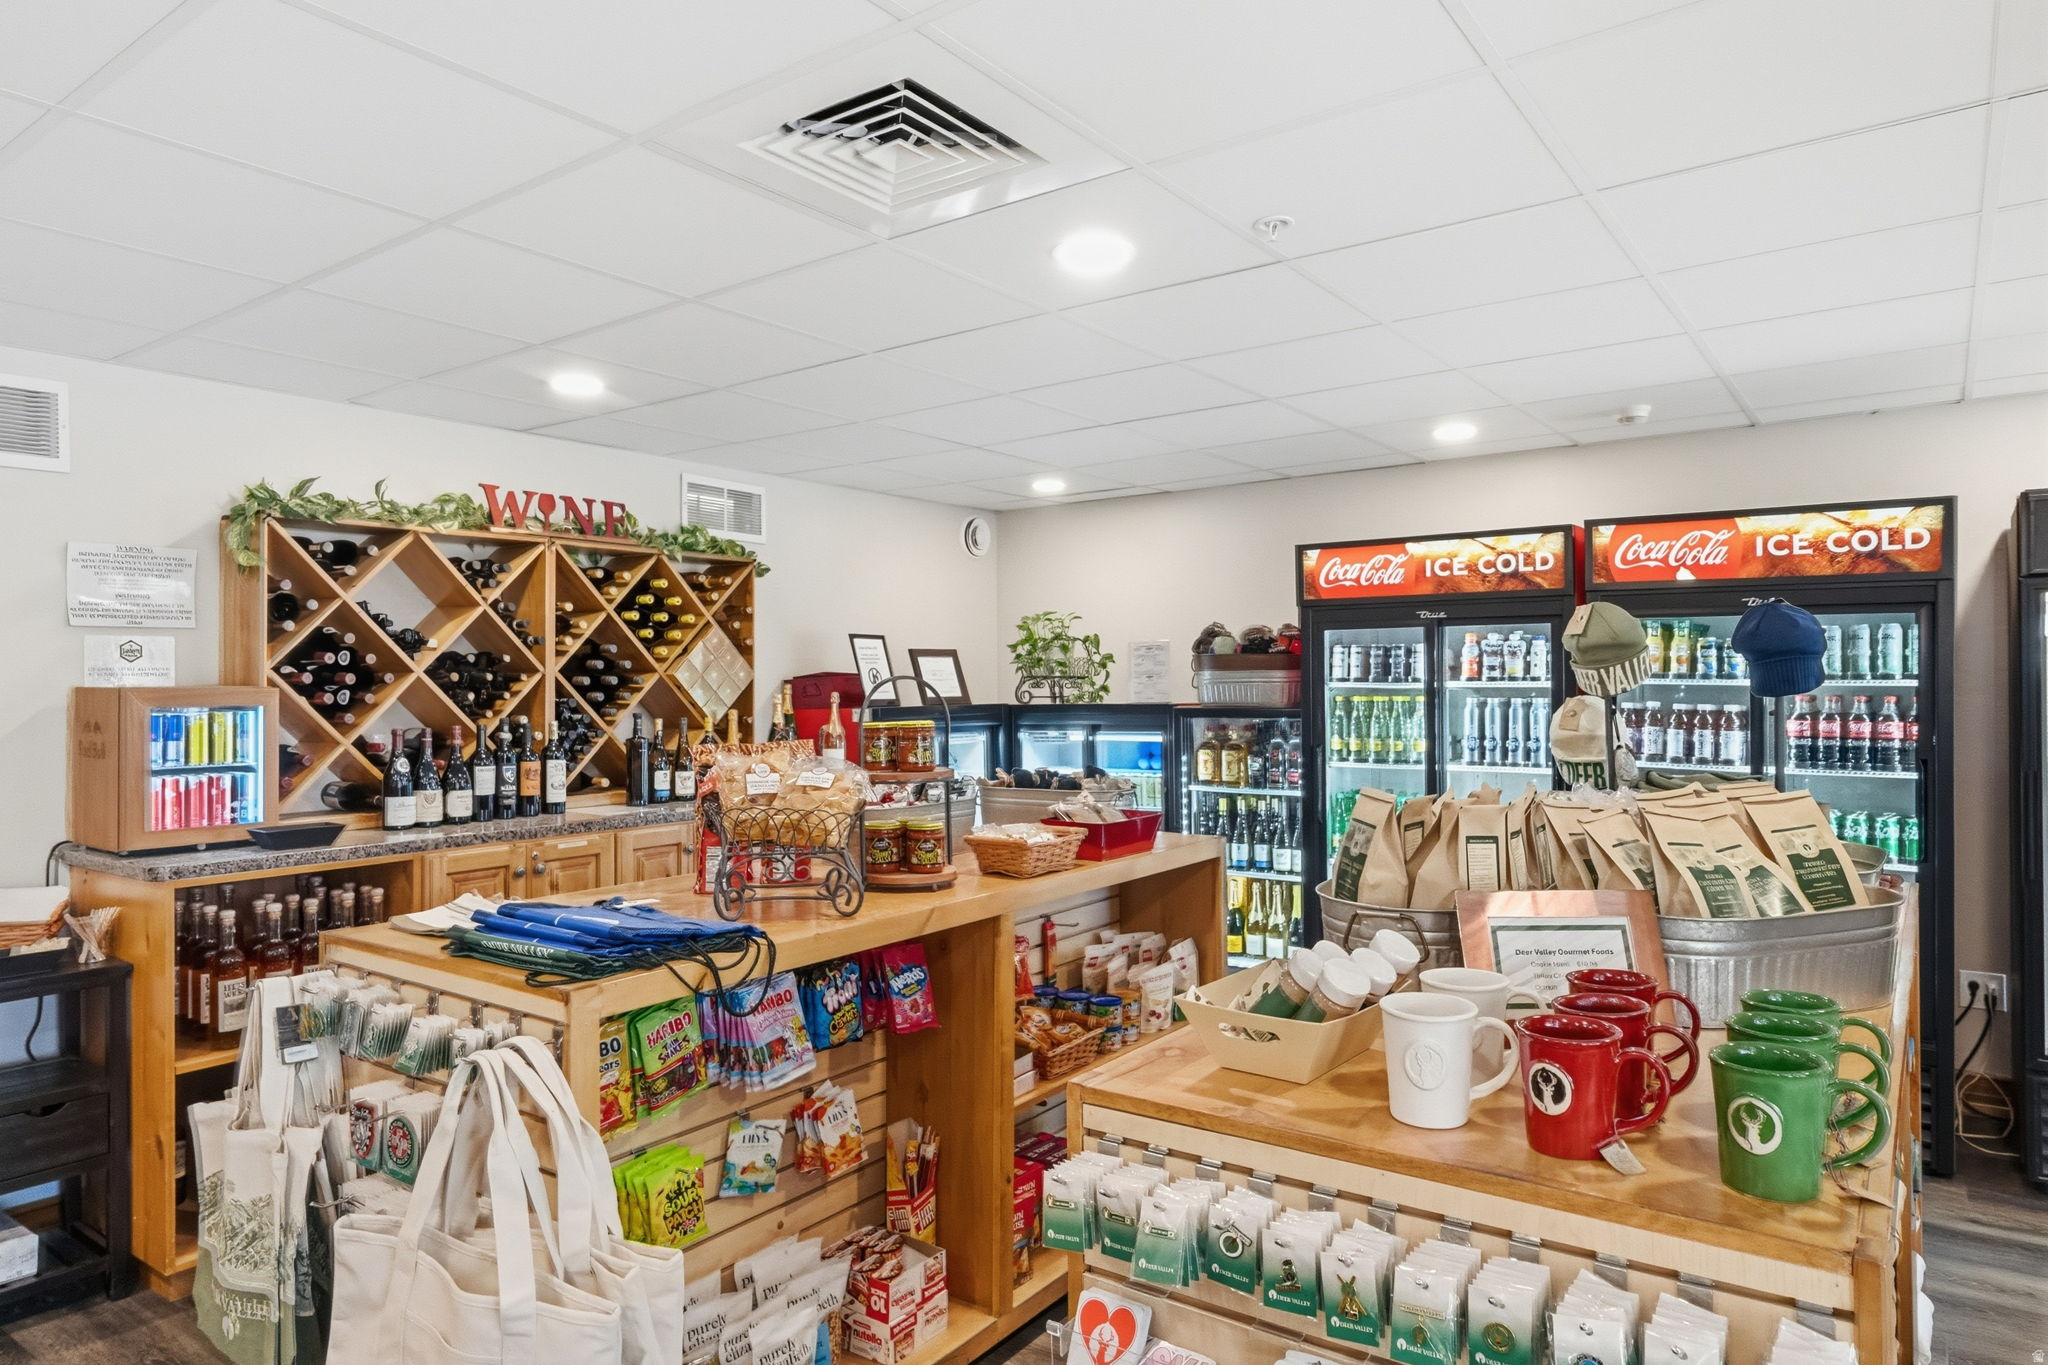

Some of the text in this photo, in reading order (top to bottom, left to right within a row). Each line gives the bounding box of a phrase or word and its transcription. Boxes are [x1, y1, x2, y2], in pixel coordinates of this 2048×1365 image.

[1614, 527, 1931, 569] Coca-Cola ICE COLD
[1319, 551, 1555, 588] Coca-Cola ICE COLD
[1534, 948, 1557, 956] Valley
[1557, 948, 1590, 957] Gourmet
[646, 1012, 693, 1050] HARIBO
[664, 1188, 698, 1217] SOUR
[664, 1196, 704, 1234] PATCH
[687, 1312, 727, 1342] purely
[853, 1329, 882, 1346] nutella
[760, 1337, 797, 1365] purely
